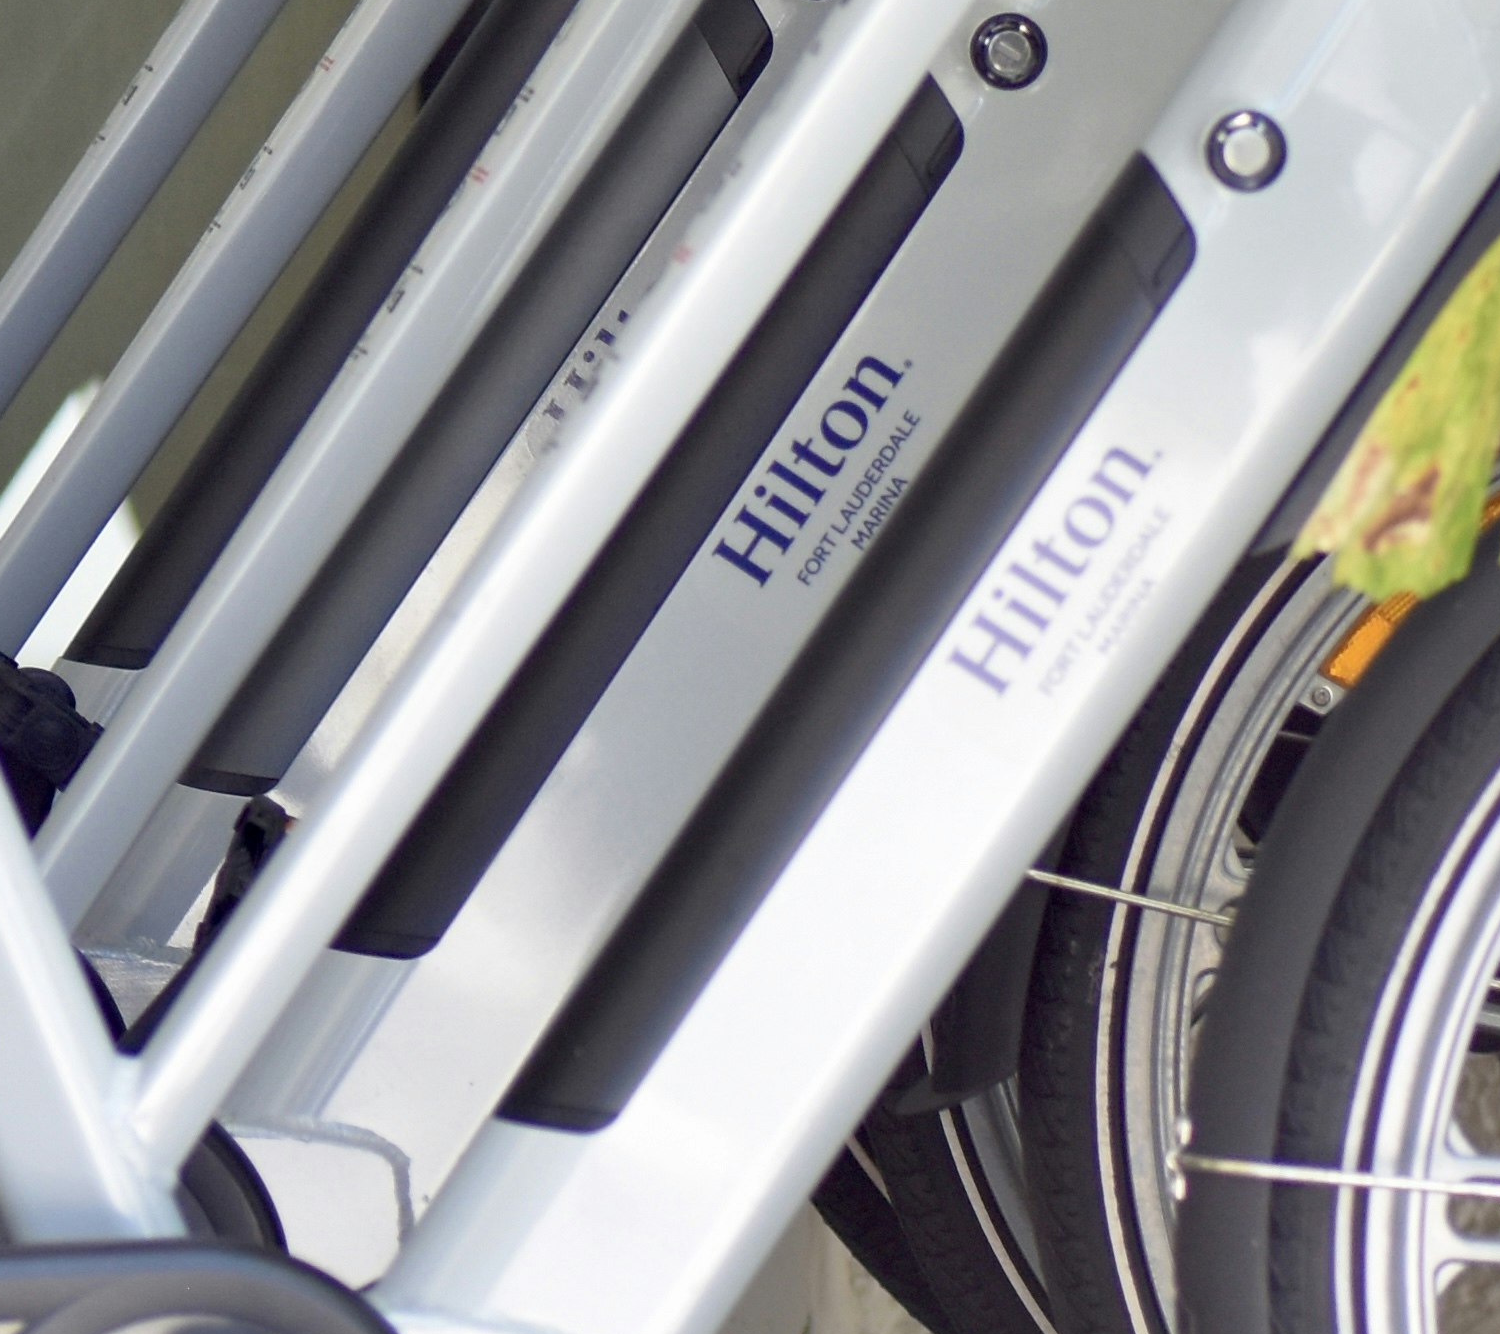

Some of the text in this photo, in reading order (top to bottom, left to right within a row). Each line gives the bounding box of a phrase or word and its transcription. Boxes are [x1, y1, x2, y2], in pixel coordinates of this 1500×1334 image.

[711, 355, 905, 588] Hilton
[797, 408, 921, 587] FORT LAUDERDALE
[851, 475, 909, 552] MARINA
[949, 446, 1153, 697] Hilton
